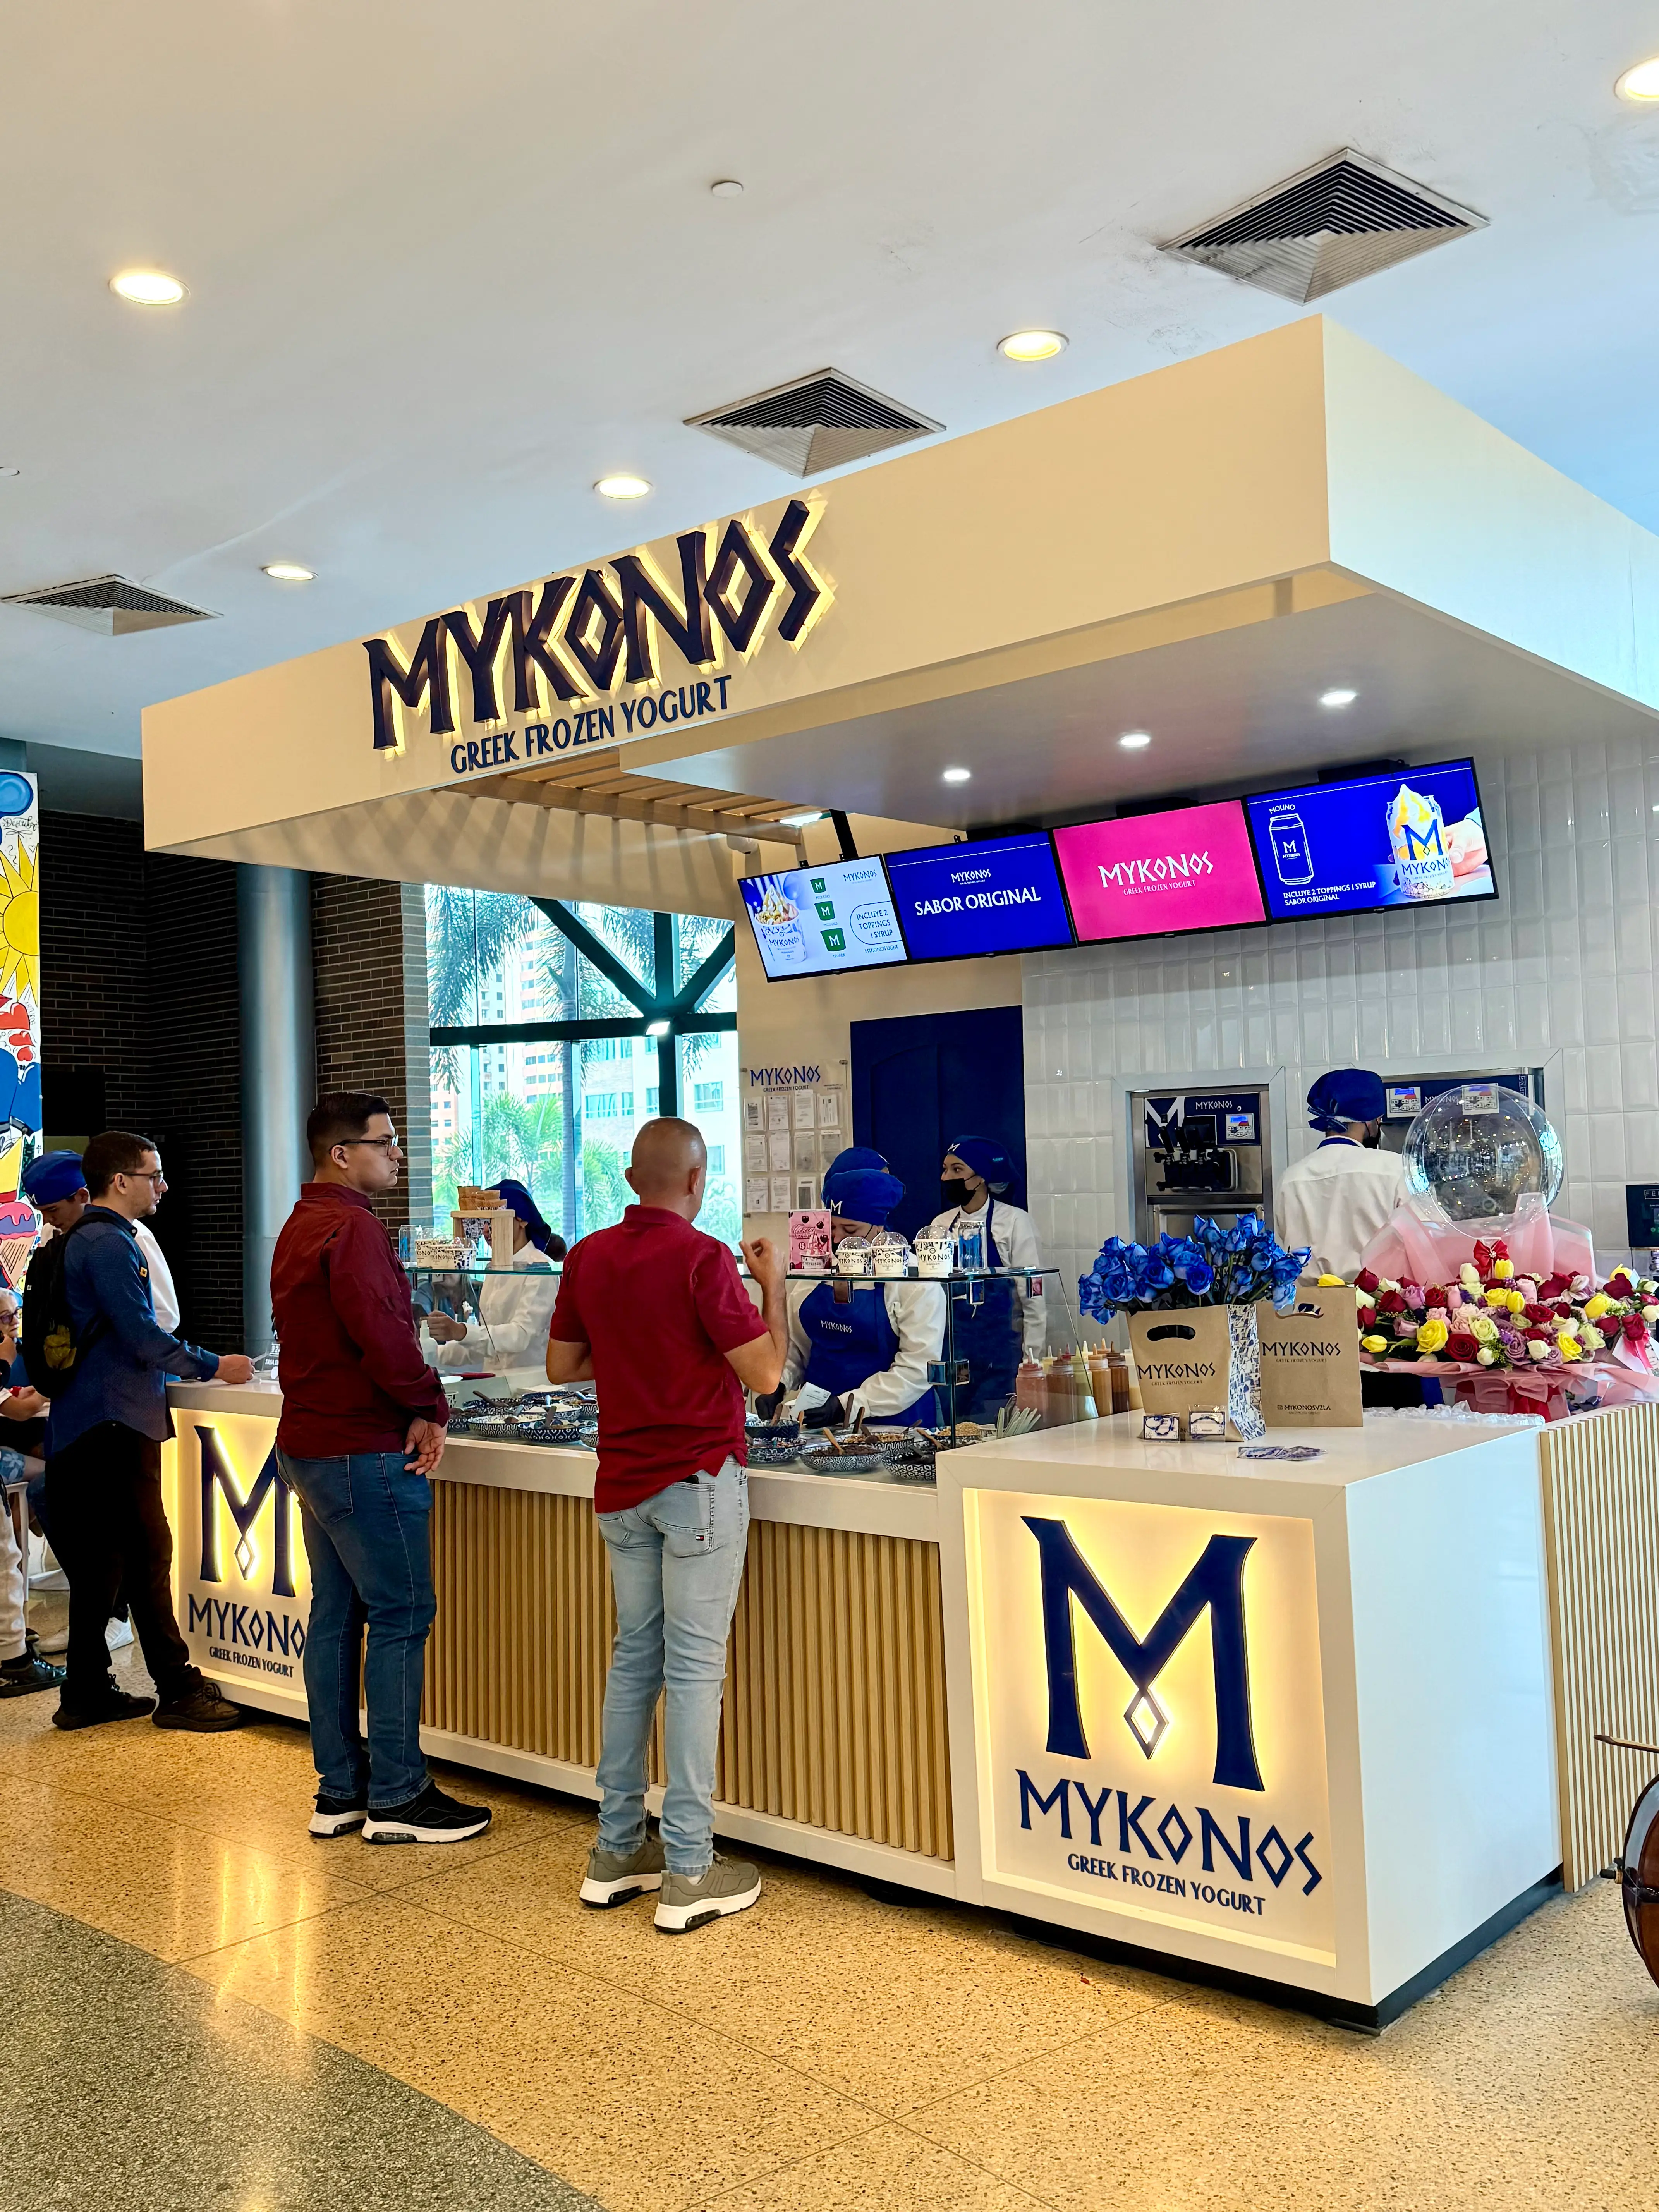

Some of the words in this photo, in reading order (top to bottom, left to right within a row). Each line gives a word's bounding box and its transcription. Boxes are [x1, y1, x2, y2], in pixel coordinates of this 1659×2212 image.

[362, 500, 821, 750] MYKONOS
[451, 735, 520, 774] GREEK
[525, 707, 615, 757] FROZEN
[620, 675, 732, 733] YOGURT
[1283, 840, 1297, 853] M
[1400, 819, 1444, 860] M
[843, 869, 877, 882] MYKONOS
[951, 869, 991, 883] MYKONOS
[1097, 850, 1214, 888] MYKONOS
[815, 882, 823, 890] M
[1123, 886, 1142, 896] GREEK
[1143, 883, 1168, 893] FROZEN
[1168, 879, 1195, 890] YOGURT
[1283, 890, 1310, 899] INCLUYE
[1316, 884, 1350, 895] TOPPINGS
[1355, 881, 1376, 890] SYRUP
[915, 896, 964, 916] SABOR
[965, 886, 1041, 909] ORIGINAL
[1285, 897, 1307, 906] SABOR
[1307, 894, 1340, 903] ORIGINAL
[821, 906, 831, 917] M
[857, 910, 882, 920] INCLUYE
[859, 920, 891, 930] TOPPINGS
[768, 936, 799, 946] MYKONOS
[828, 934, 840, 946] M
[874, 929, 893, 938] SYRUP
[750, 1065, 821, 1087] MYKONOS
[1195, 1100, 1233, 1110] MYKONOS
[830, 1199, 843, 1214] M
[821, 1320, 852, 1333] MYKONOS
[1262, 1341, 1341, 1356] MYKONOS
[1137, 1362, 1216, 1379] MYKONOS
[194, 1425, 295, 1597] M
[187, 1593, 305, 1659] MYKONO
[1020, 1515, 1265, 1792] M
[209, 1646, 232, 1662] GREEK
[233, 1651, 261, 1670] FROZEN
[262, 1658, 294, 1678] YOGURT
[1015, 1768, 1323, 1896] MYKONOS
[1067, 1853, 1119, 1881] GREEK
[1122, 1865, 1187, 1899] FROZEN
[1190, 1881, 1266, 1916] YOGURT
